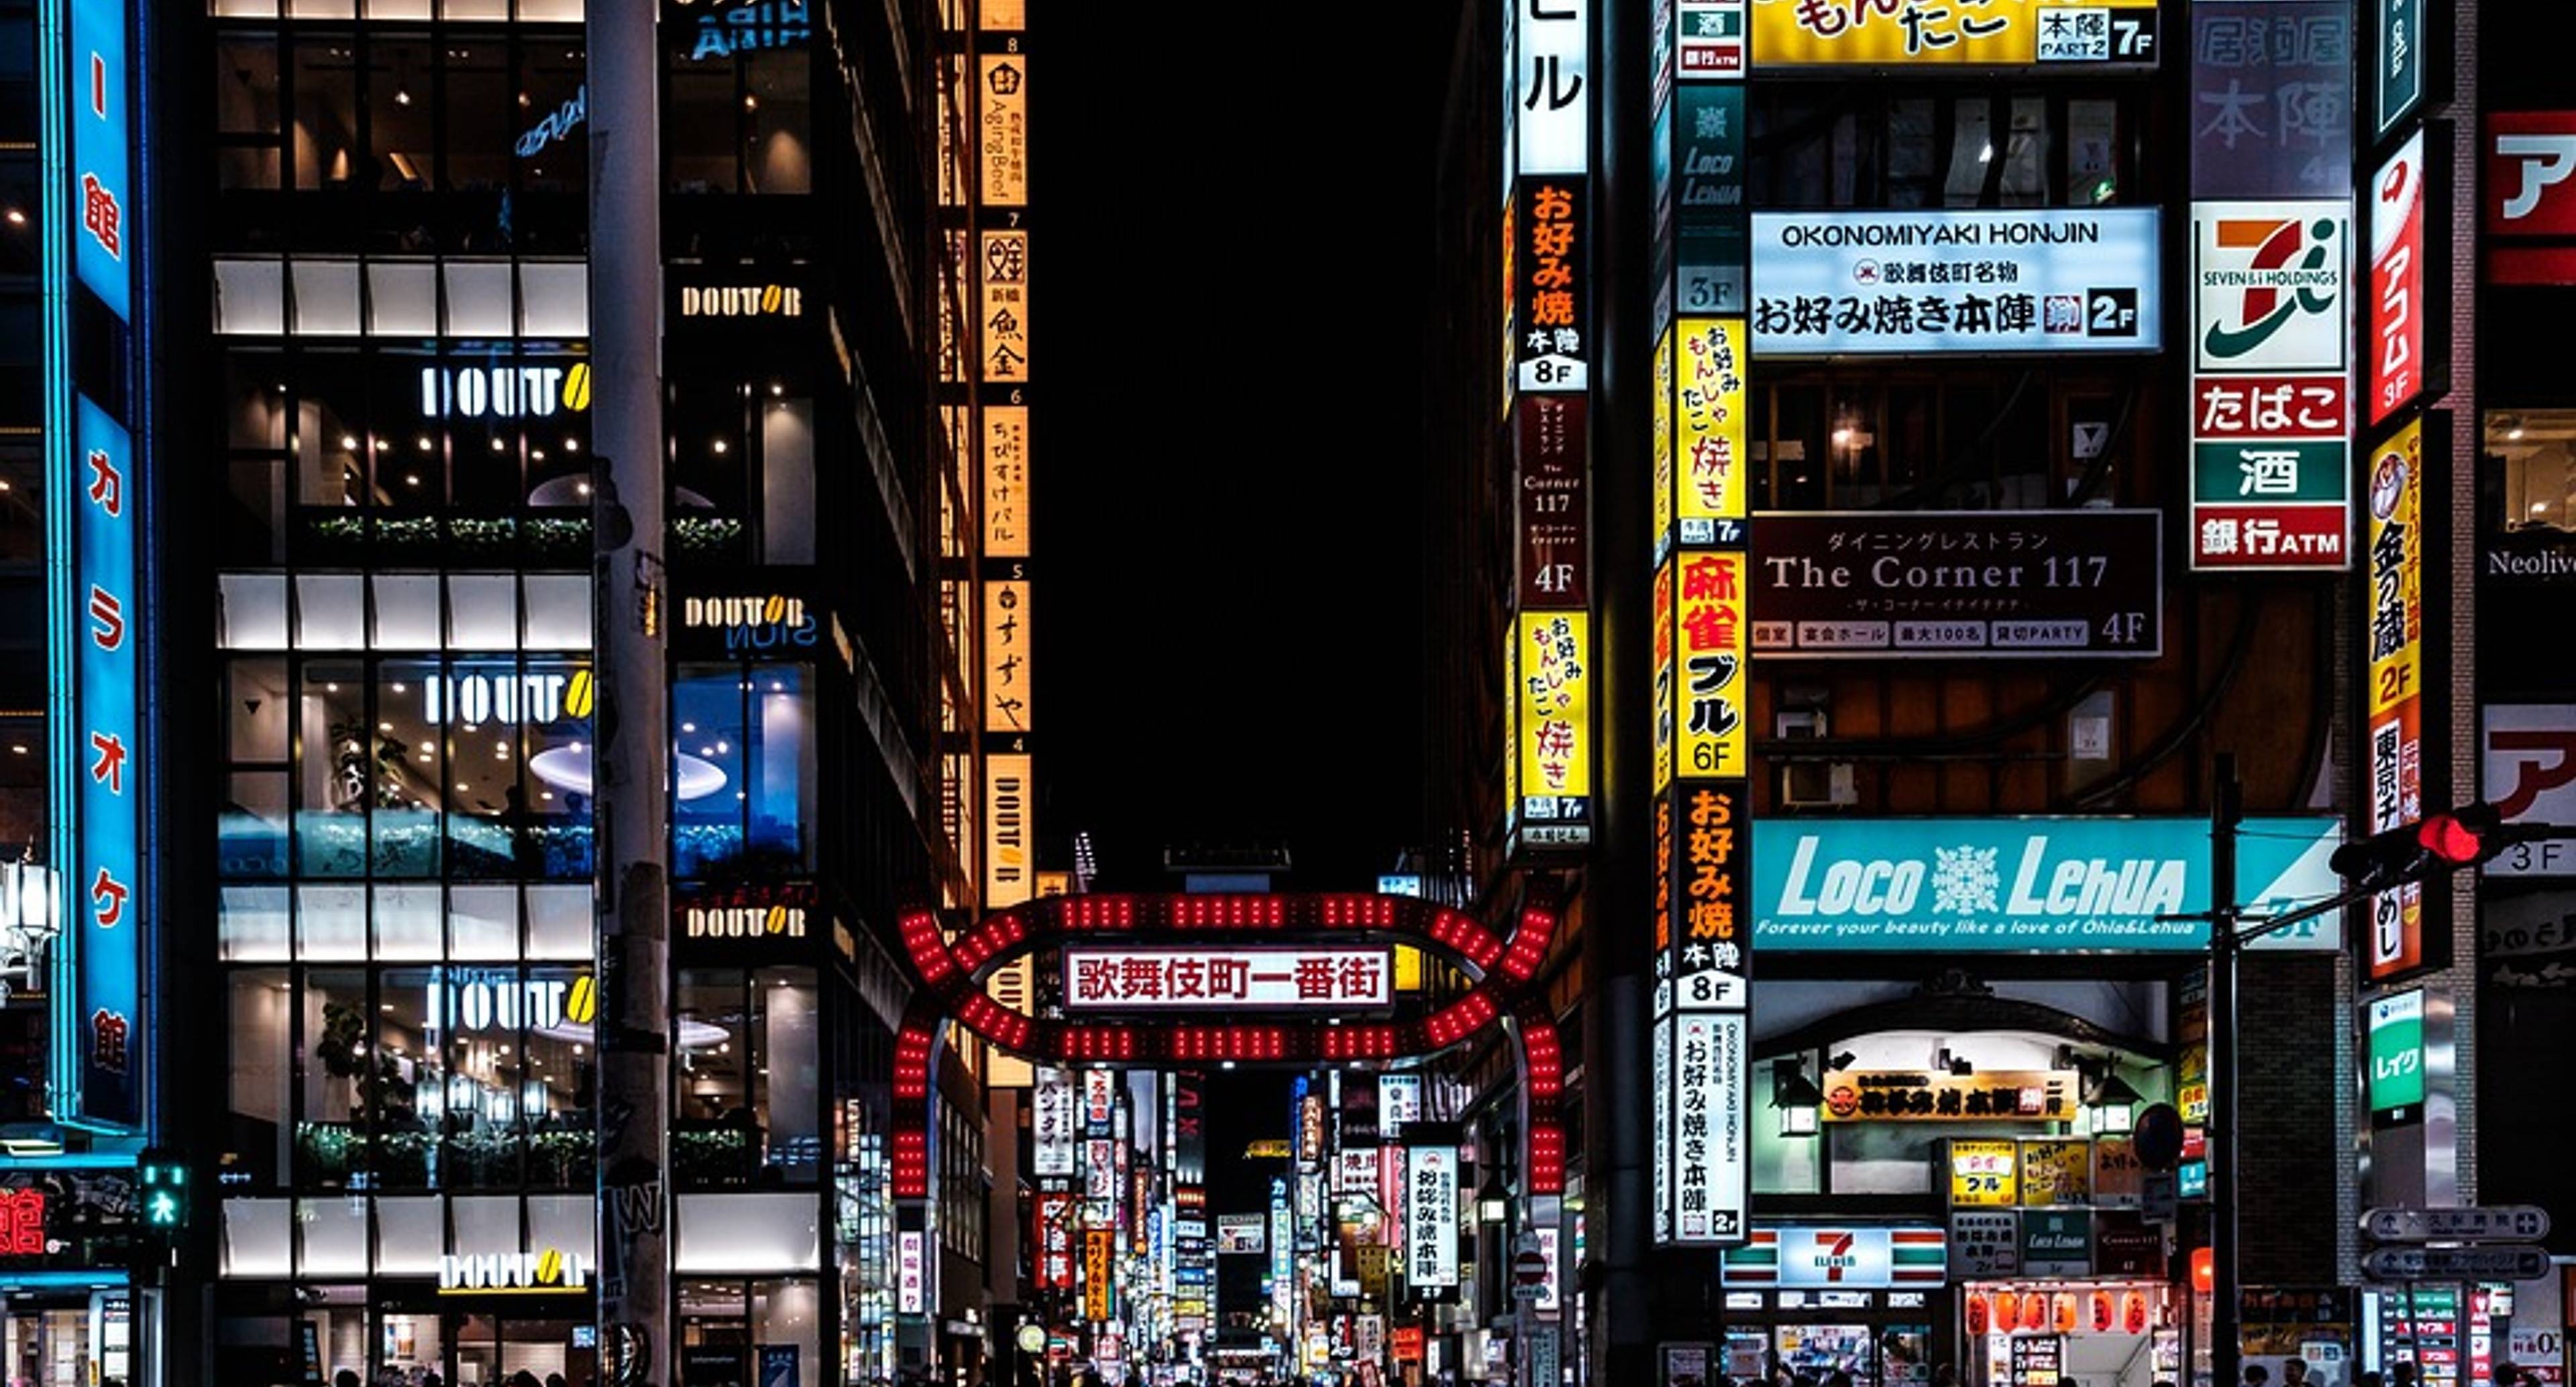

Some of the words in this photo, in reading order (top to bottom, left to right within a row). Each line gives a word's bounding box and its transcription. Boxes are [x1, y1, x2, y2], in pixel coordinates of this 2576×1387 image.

[1699, 13, 1725, 37] 酒
[2044, 13, 2107, 39] 本陣
[2113, 21, 2152, 56] 7F
[1008, 38, 1018, 52] 8
[2041, 41, 2105, 56] PART2
[1009, 213, 1020, 227] 7
[1782, 224, 1980, 247] OKONOMIYAKI
[1990, 223, 2099, 244] HONJIN
[1533, 186, 1574, 326] お好み焼
[1884, 262, 2019, 284] 歌舞伎町名物
[2265, 270, 2338, 286] HOLDINGS
[682, 284, 802, 316] DOUTOR
[1689, 276, 1733, 307] 3F
[1754, 293, 2037, 335] お好み焼き本陣
[2092, 295, 2133, 329] 2F
[2383, 244, 2411, 377] アコム
[989, 308, 1025, 377] 魚金
[1527, 329, 1580, 353] 本陣
[1535, 362, 1571, 383] 8F
[1708, 326, 1741, 392] お好み
[422, 363, 590, 417] DOUTO
[1012, 391, 1021, 404] 6
[1682, 389, 1709, 431] たこ
[2202, 385, 2338, 431] たばこ
[1690, 435, 1731, 510] 焼き
[2239, 449, 2301, 496] 酒
[1536, 494, 1570, 512] 117
[1717, 520, 1741, 542] 7F
[1828, 532, 2049, 551] ダイニングレストラン
[2202, 518, 2339, 555] 銀行ATM
[1013, 564, 1023, 579] 5
[1535, 564, 1574, 593] 4F
[1766, 556, 1851, 588] The
[1872, 556, 2025, 588] Corner
[2044, 556, 2108, 588] 117
[685, 595, 805, 628] DOUTOR
[1756, 626, 1787, 642] 個室
[1806, 626, 1884, 642] 宴会ホール
[1900, 626, 1981, 642] 最大100名
[1996, 626, 2084, 642] 貸切PARTY
[2102, 613, 2146, 644] 4F
[1551, 618, 1582, 678] お好み
[995, 616, 1023, 732] すずや
[2380, 664, 2411, 704] 2F
[425, 670, 593, 725] DOUTO
[1527, 676, 1553, 716] たこ
[88, 449, 129, 1072] カラオケ館
[1013, 737, 1023, 752] 4
[1536, 720, 1574, 789] 焼き
[1694, 741, 1731, 771] 6F
[995, 777, 1023, 882] DOUTOR
[1688, 790, 1734, 938] お好み焼
[2512, 843, 2563, 871] 3F
[1778, 836, 1927, 915] Loco
[688, 905, 806, 937] DOUTOR
[1756, 920, 1833, 936] Forever
[1837, 922, 1882, 937] your
[1885, 920, 1952, 936] beauty
[1956, 920, 1991, 934] like
[1995, 923, 2007, 934] a
[2010, 920, 2051, 934] love
[2054, 920, 2080, 934] of
[1683, 940, 1741, 968] 本陣
[1077, 958, 1381, 1000] 歌舞伎町一番街
[1692, 976, 1731, 1001] 8F
[427, 975, 596, 1030] DOUTO
[2376, 1048, 2420, 1080] レイク
[1683, 1040, 1707, 1213] お好み焼き本陣
[1714, 1213, 1737, 1233] 2F
